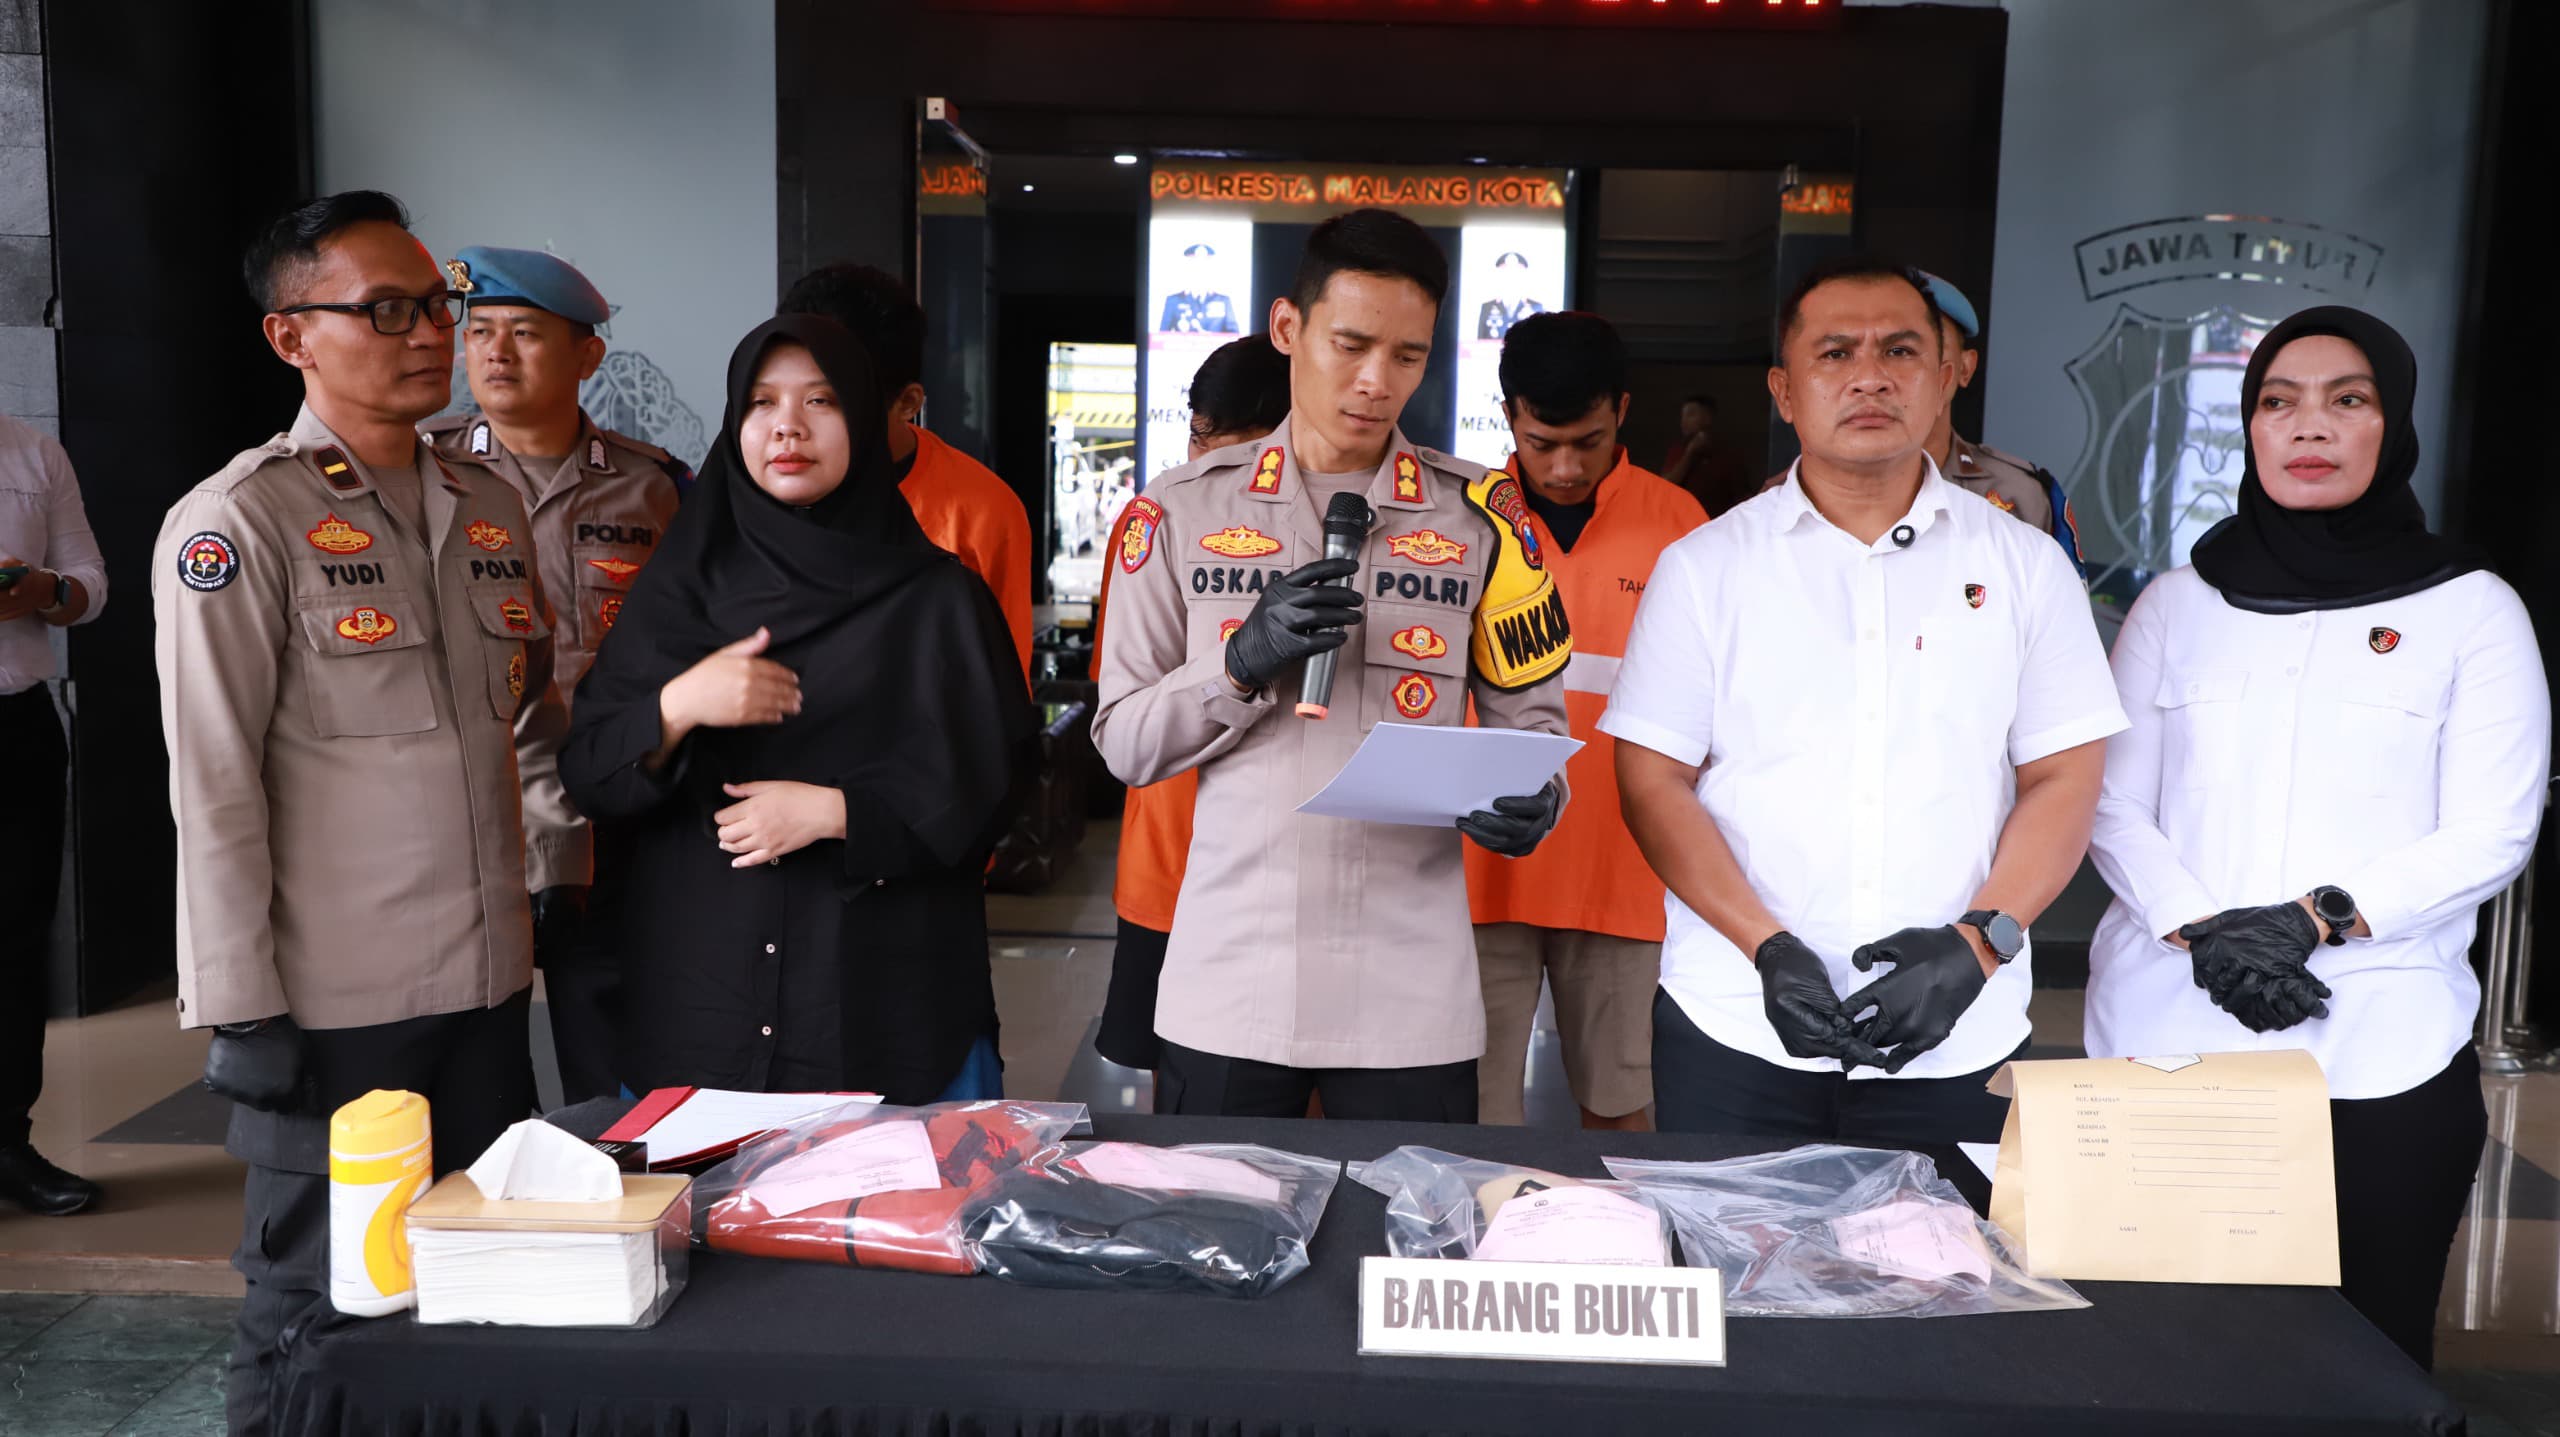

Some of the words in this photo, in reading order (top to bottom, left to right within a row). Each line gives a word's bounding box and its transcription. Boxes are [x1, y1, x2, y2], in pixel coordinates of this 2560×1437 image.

[1151, 171, 1315, 201] POLRESTA
[1324, 175, 1472, 206] MALANG
[1476, 177, 1564, 207] KOTA
[2098, 233, 2212, 276] JAWA
[578, 524, 653, 547] POLRI
[320, 562, 385, 587] YUDI
[470, 559, 528, 582] POLRI
[1376, 571, 1469, 607] POLRI
[1617, 578, 1646, 595] TAH
[1383, 1277, 1560, 1334] BARANG
[1574, 1283, 1699, 1339] BUKTI
